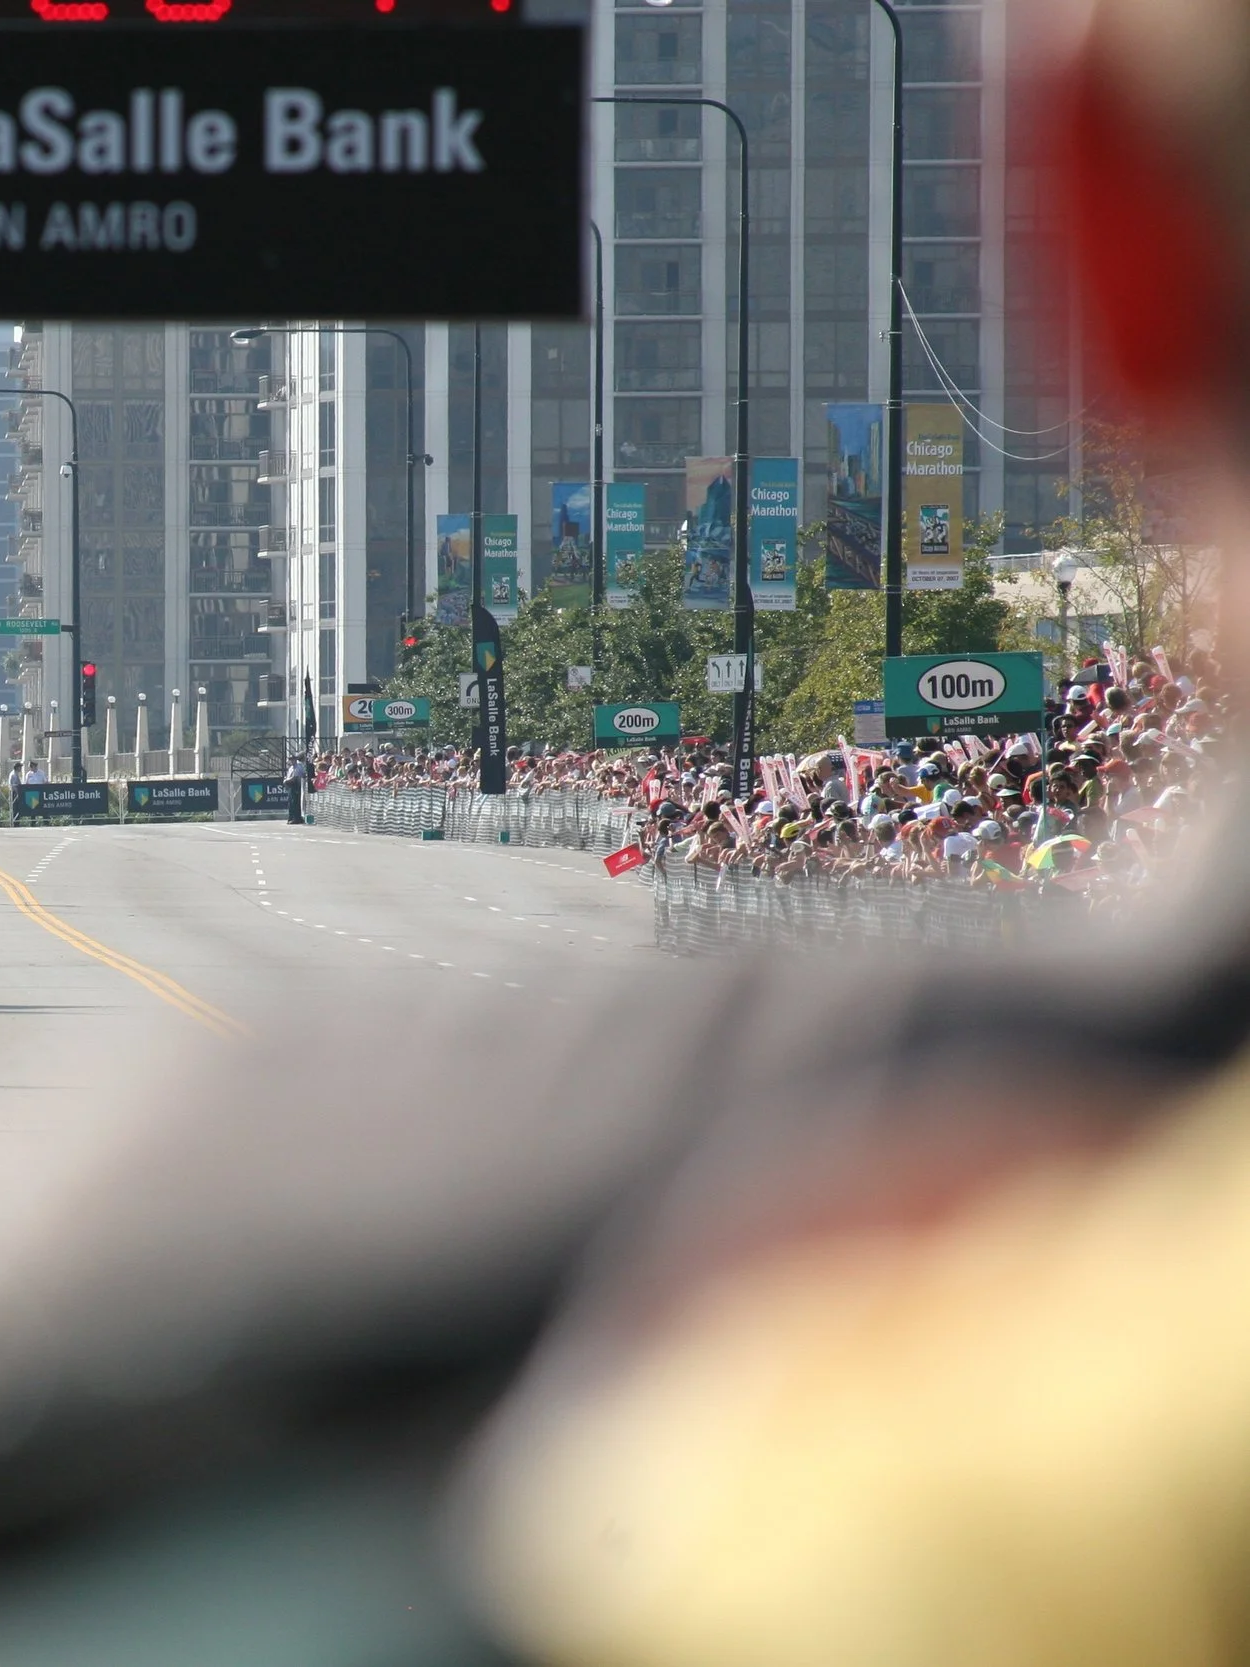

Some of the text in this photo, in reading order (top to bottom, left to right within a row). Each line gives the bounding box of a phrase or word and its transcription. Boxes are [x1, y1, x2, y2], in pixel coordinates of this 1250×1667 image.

[265, 86, 484, 173] Bank
[40, 201, 197, 251] AMRO
[906, 440, 953, 459] Chicago
[906, 461, 963, 476] Marathon
[751, 487, 790, 502] Chicago
[606, 507, 638, 520] Chicago
[751, 504, 798, 517] Marathon
[606, 521, 645, 532] Marathon
[484, 536, 512, 547] Chicago
[484, 549, 518, 558] Marathon
[5, 620, 48, 628] ROOSEVELT
[927, 674, 994, 699] 100m
[387, 706, 413, 716] 300m
[486, 678, 502, 757] LaSalle Bank
[618, 714, 654, 729] 200m
[943, 714, 1000, 726] LaSalle Bank
[43, 790, 101, 801] LaSalle Bank
[152, 787, 211, 798] LaSalle Bank
